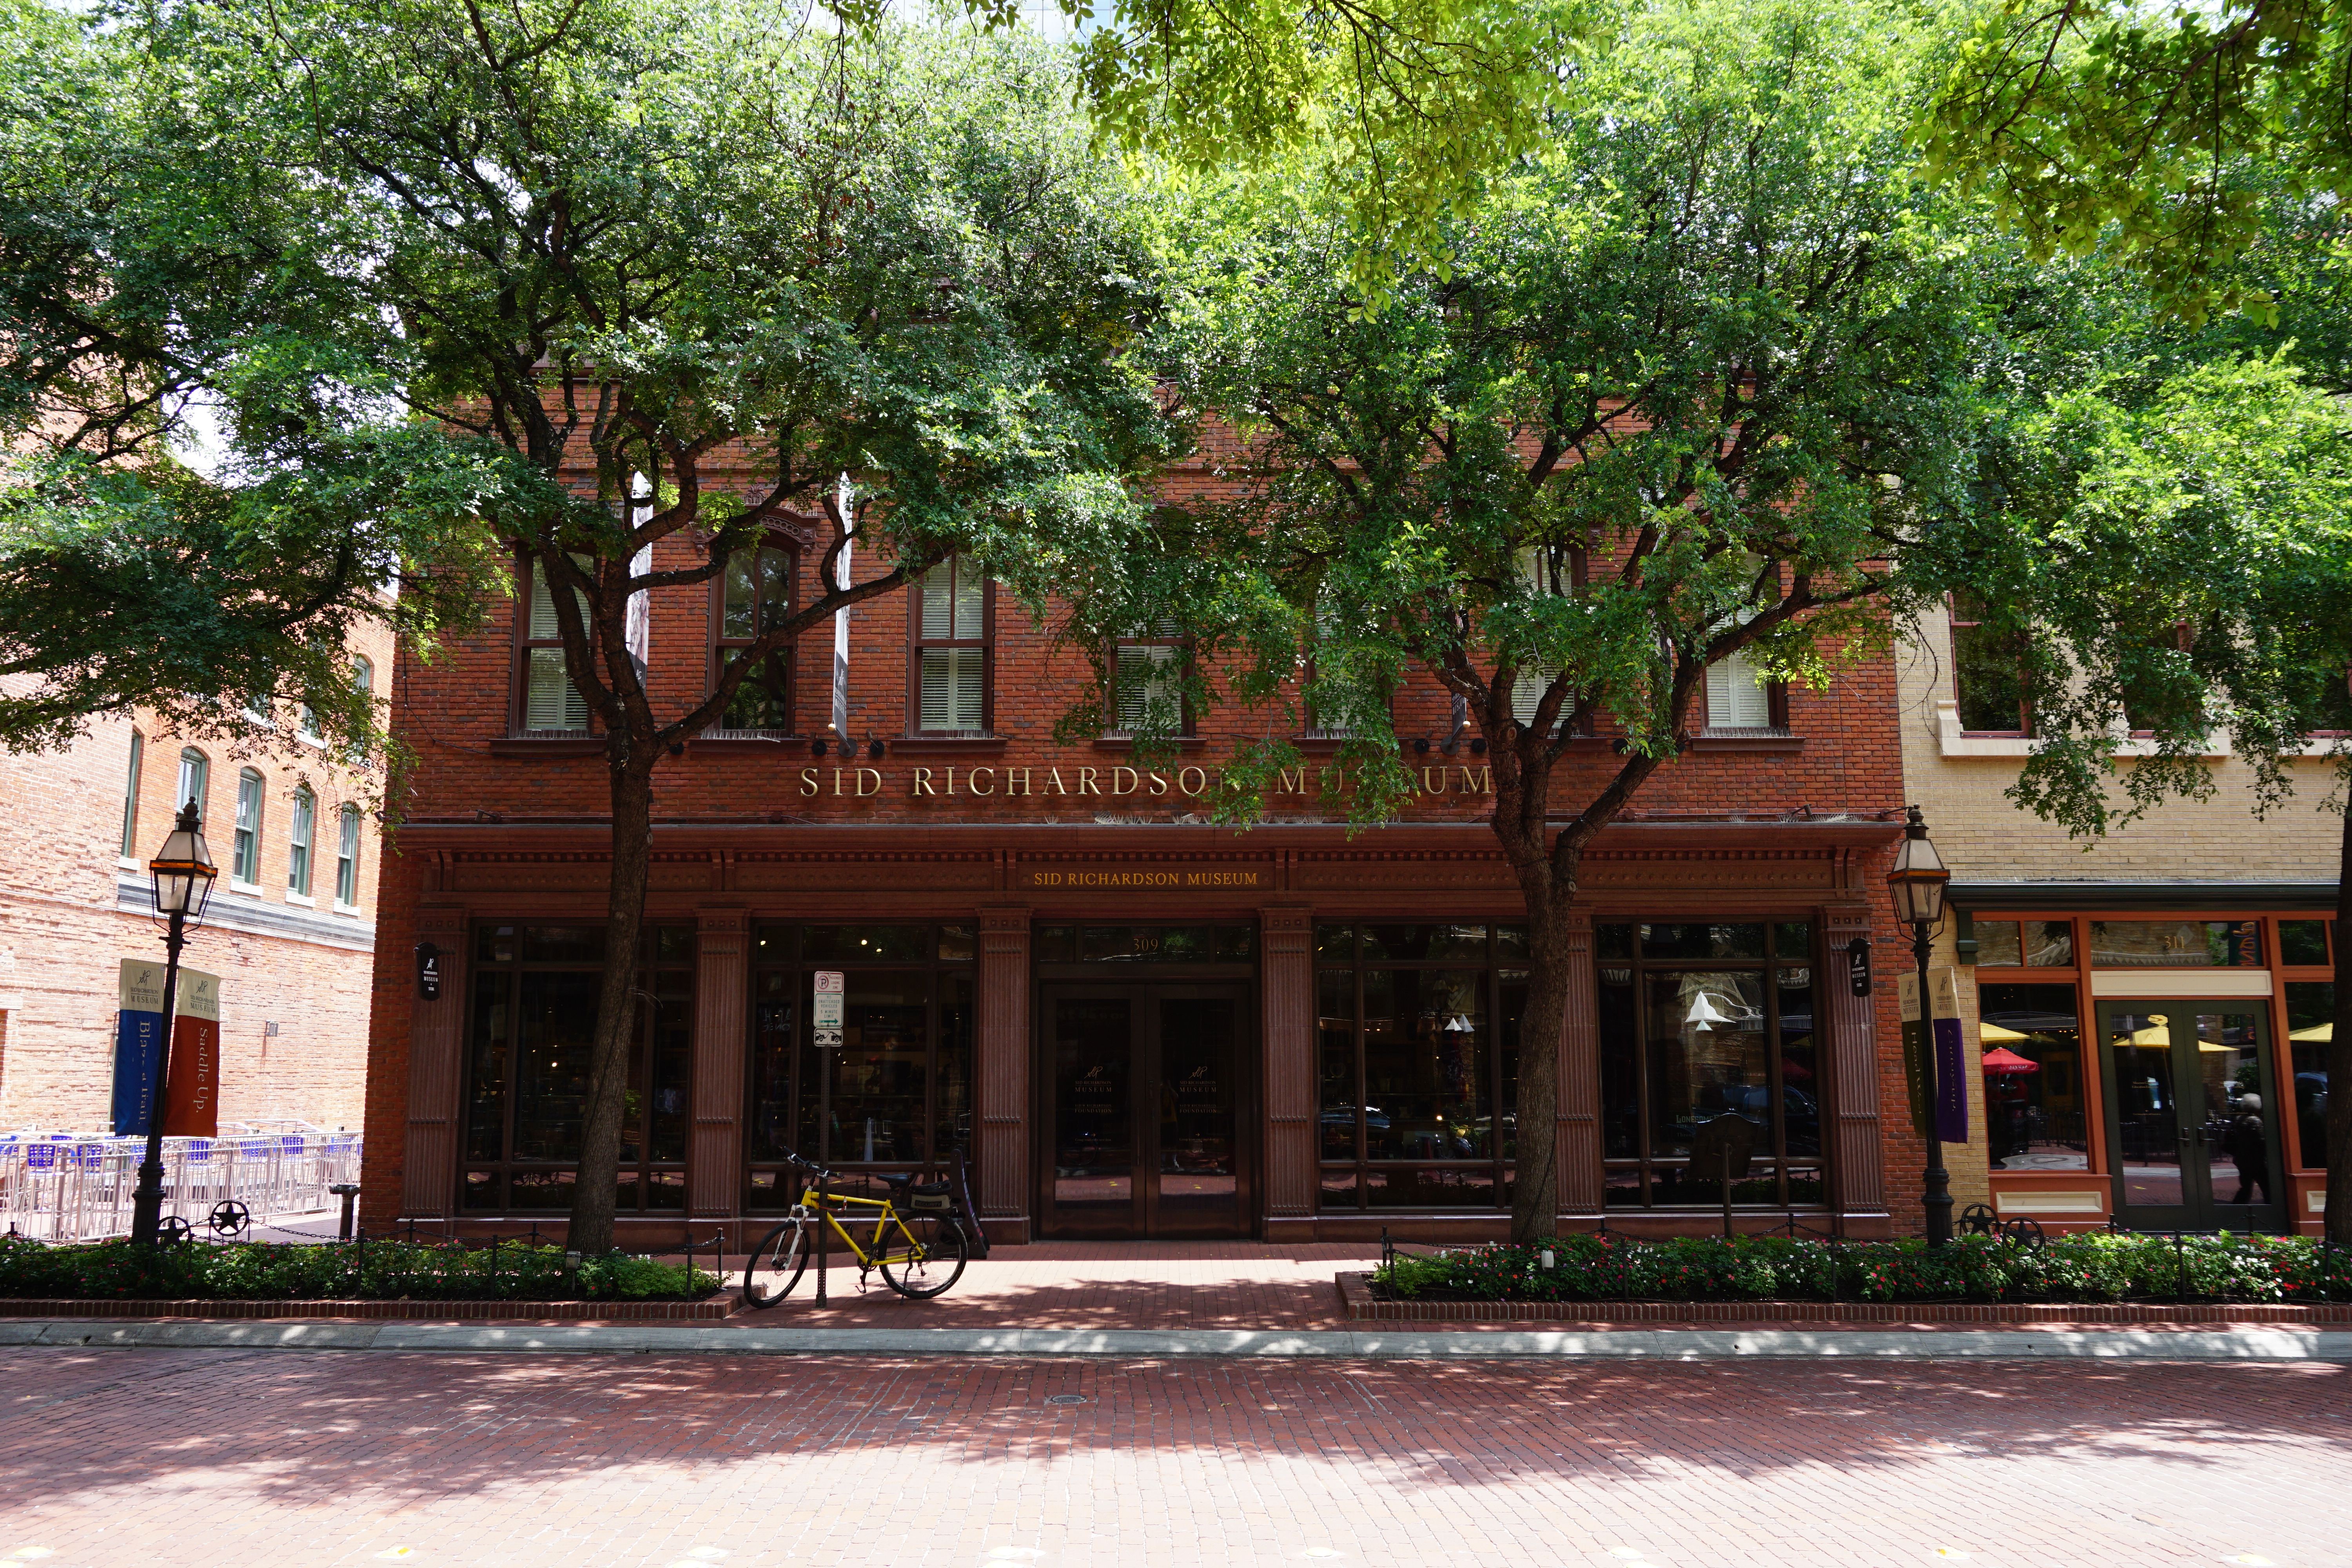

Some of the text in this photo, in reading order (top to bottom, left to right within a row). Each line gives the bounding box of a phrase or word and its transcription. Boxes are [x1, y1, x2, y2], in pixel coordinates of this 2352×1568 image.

[800, 768, 881, 797] SID
[1275, 766, 1491, 795] MUUM
[1034, 872, 1258, 885] SID RICHARDSON MUSEUM
[1133, 938, 1158, 951] 309
[2164, 936, 2185, 949] 311
[131, 995, 158, 1004] MUSEUM
[191, 1002, 216, 1014] MUSEUM
[193, 1027, 209, 1113] Saddle Up.
